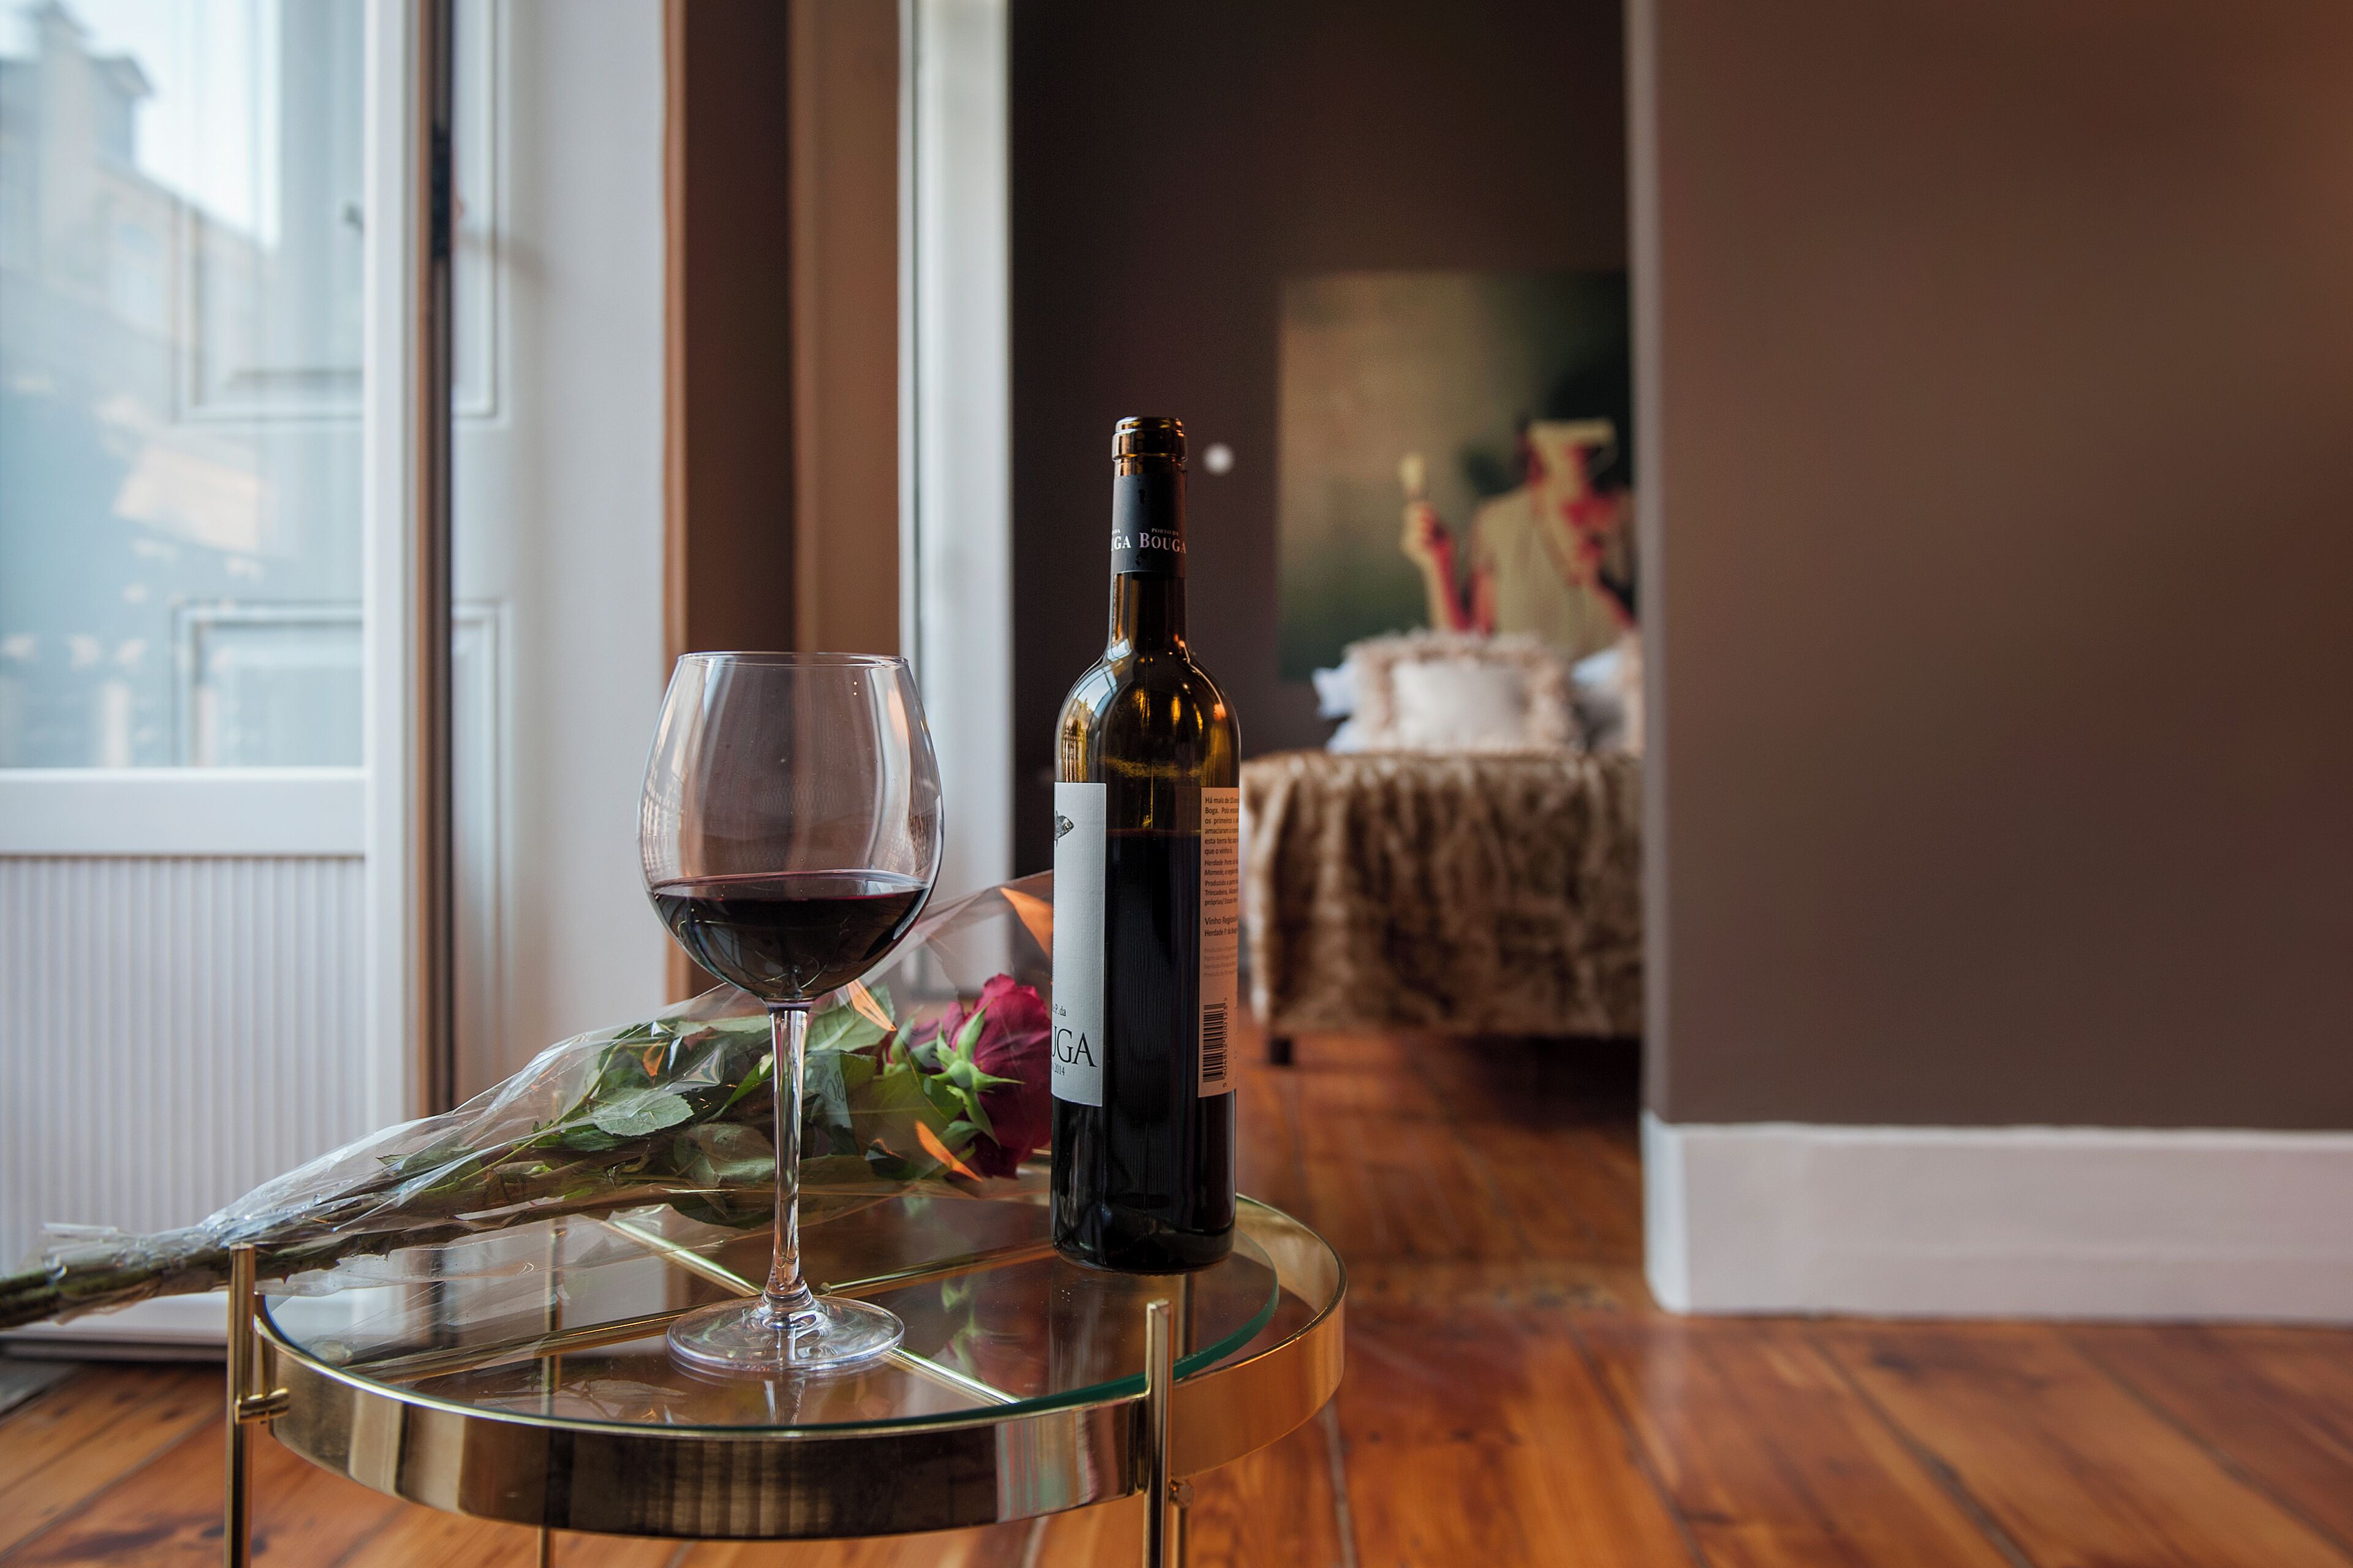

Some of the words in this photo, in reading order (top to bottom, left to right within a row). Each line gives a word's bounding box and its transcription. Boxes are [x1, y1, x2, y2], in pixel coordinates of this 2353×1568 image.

[1139, 532, 1186, 555] BOUGA
[1205, 917, 1221, 925] Vinho
[1055, 1063, 1065, 1076] 2014
